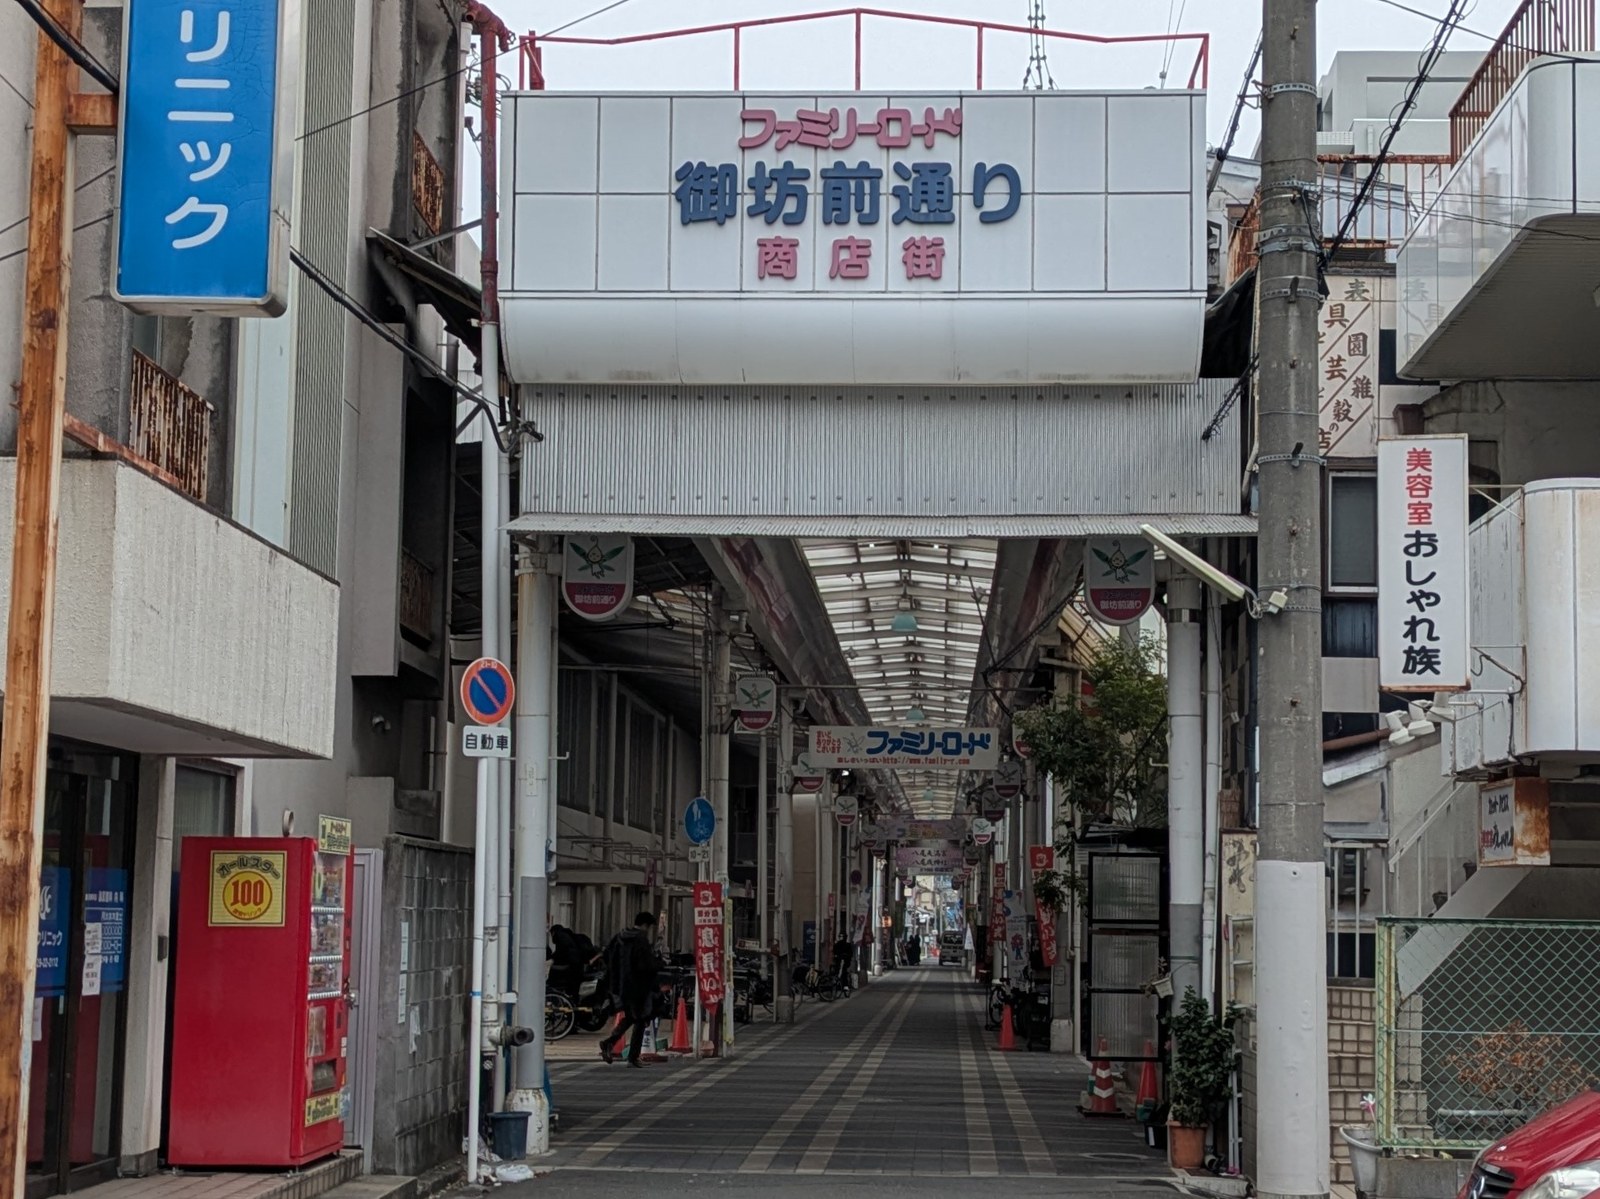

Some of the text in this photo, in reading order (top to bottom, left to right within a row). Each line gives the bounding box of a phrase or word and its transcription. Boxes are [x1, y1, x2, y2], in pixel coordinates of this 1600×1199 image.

[165, 11, 234, 249] リニック
[738, 107, 963, 150] ファミリーロード
[674, 160, 1022, 225] 御坊前通り
[757, 236, 945, 279] 商店街
[1402, 447, 1441, 676] 美容室 おしゃれ族
[465, 733, 508, 750] 自動車
[866, 731, 991, 756] ファミリーロード
[216, 855, 281, 879] オールスター
[690, 849, 709, 860] 10-21
[231, 879, 265, 907] 100
